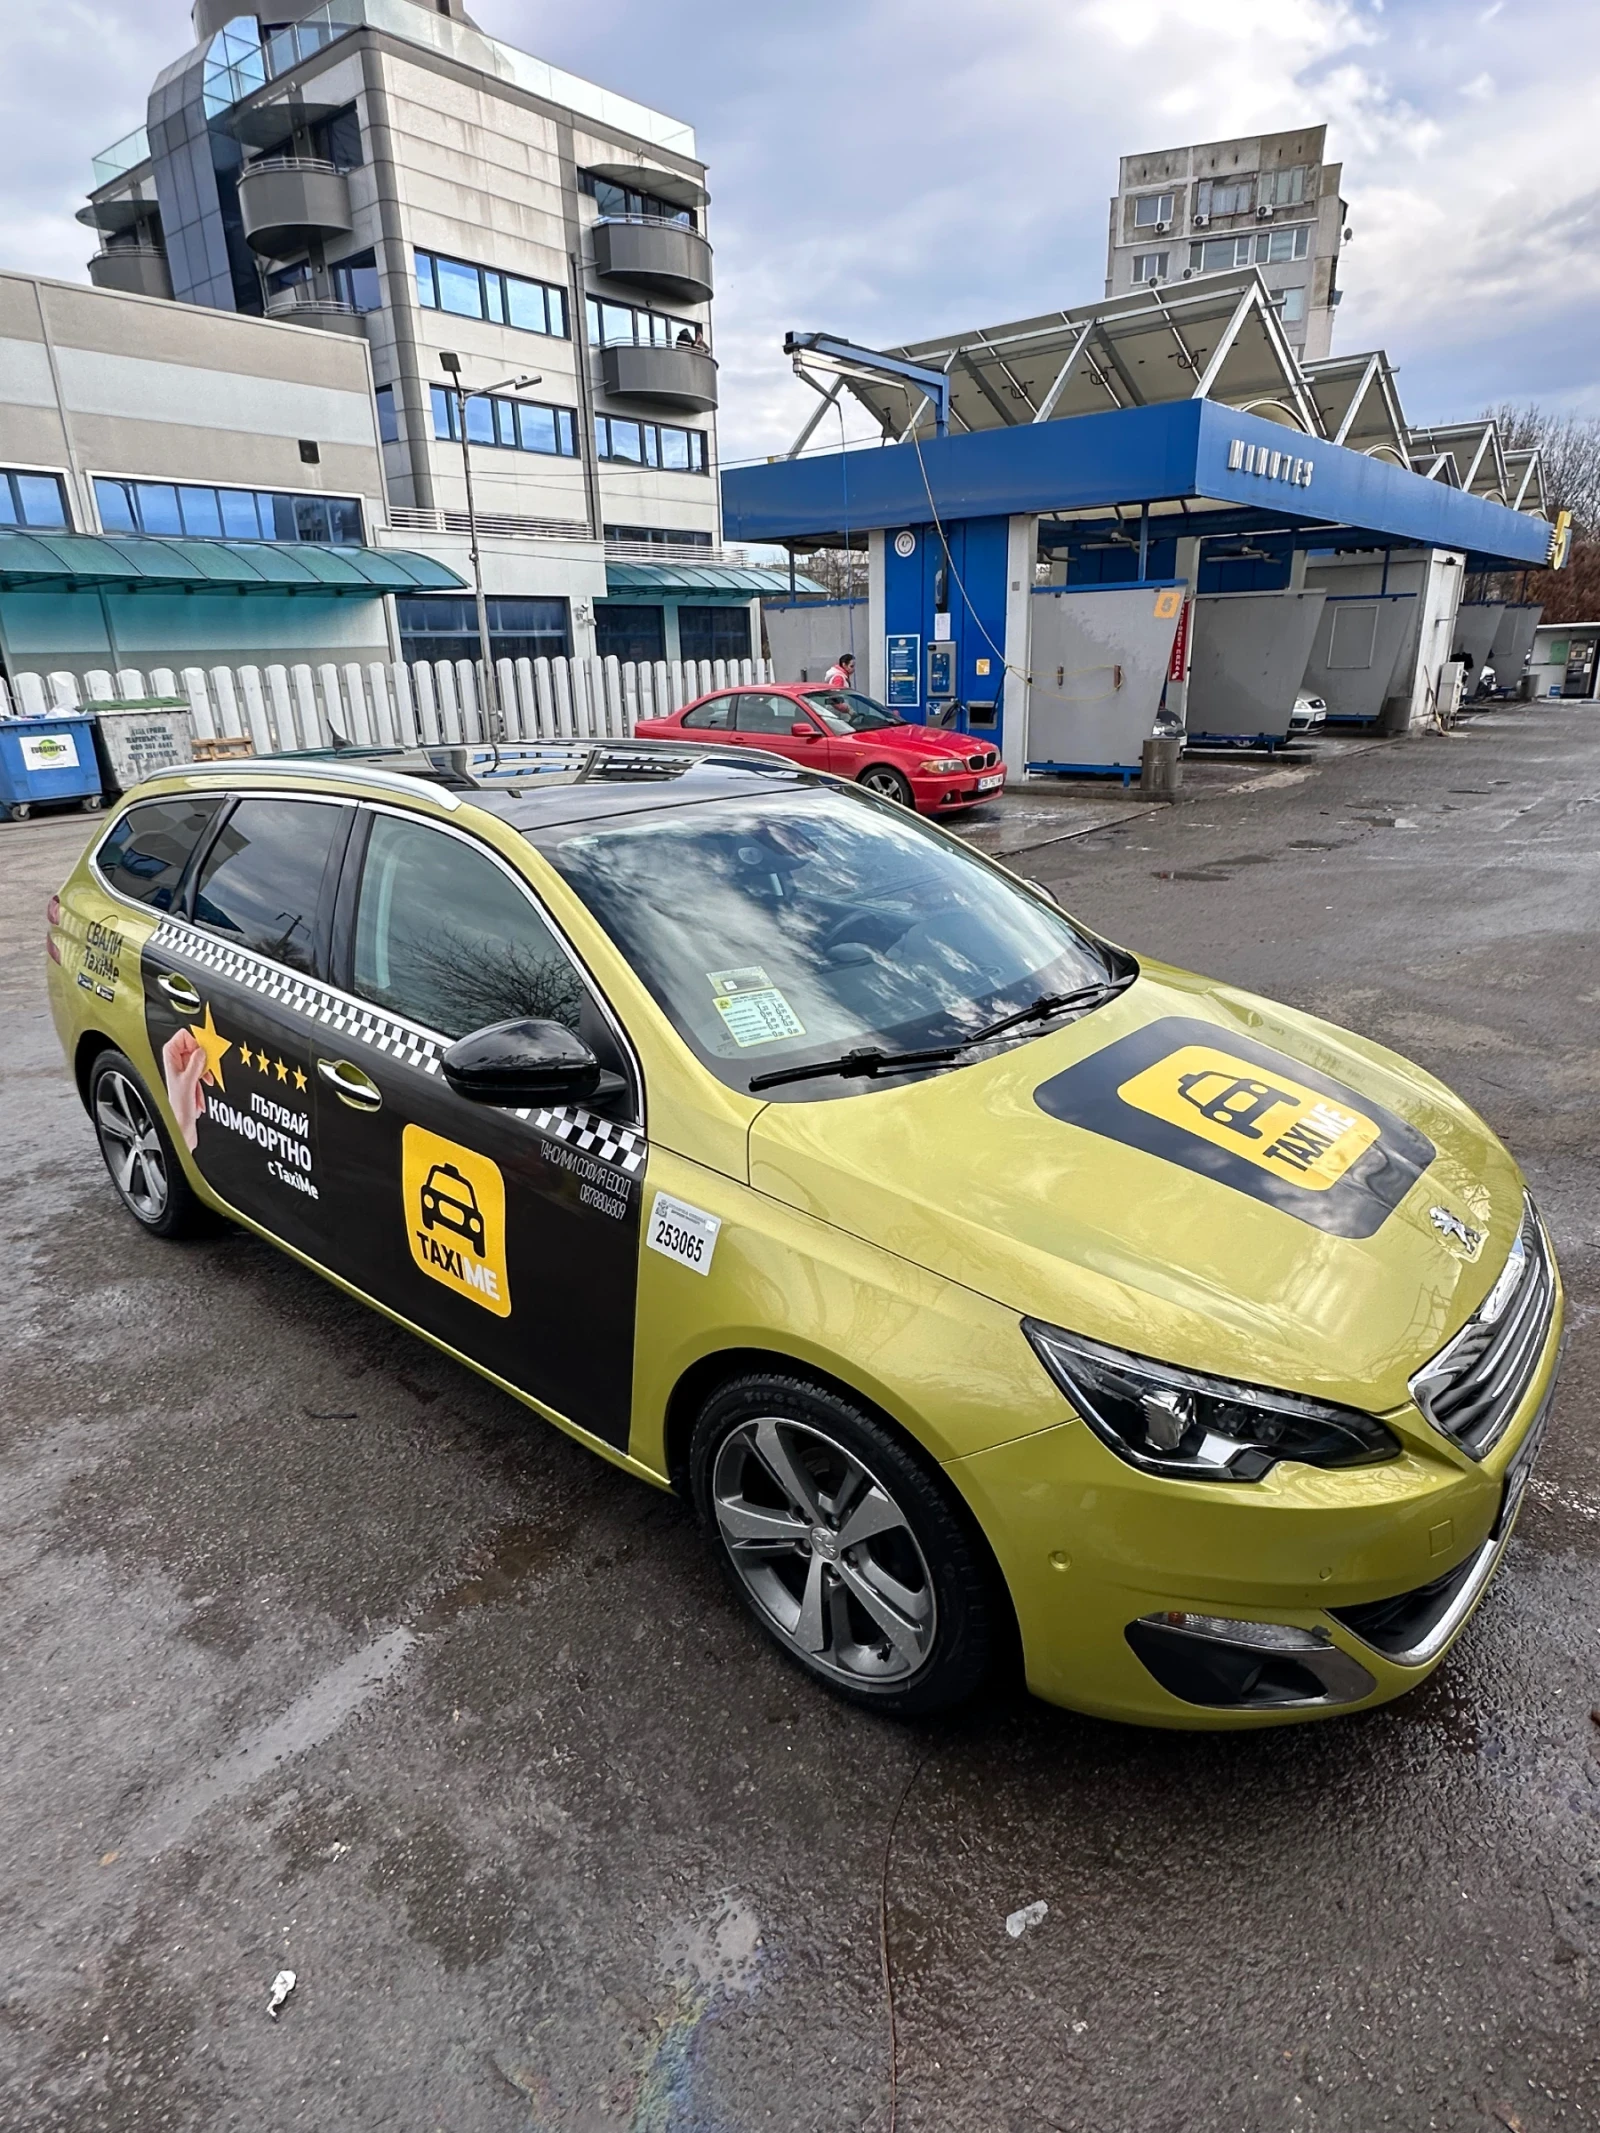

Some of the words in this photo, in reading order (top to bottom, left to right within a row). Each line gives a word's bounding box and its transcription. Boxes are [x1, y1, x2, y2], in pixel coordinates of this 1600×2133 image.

[1228, 440, 1314, 487] MINUTES
[87, 921, 124, 958] СВАЛИ
[84, 945, 120, 984] TaxiMe
[208, 1096, 312, 1171] КОМФОРТНО
[251, 1092, 309, 1139] ПЪТУВАЙ
[274, 1161, 320, 1200] TaxiMe
[605, 1171, 632, 1202] ЕООД
[655, 1220, 705, 1262] 253065
